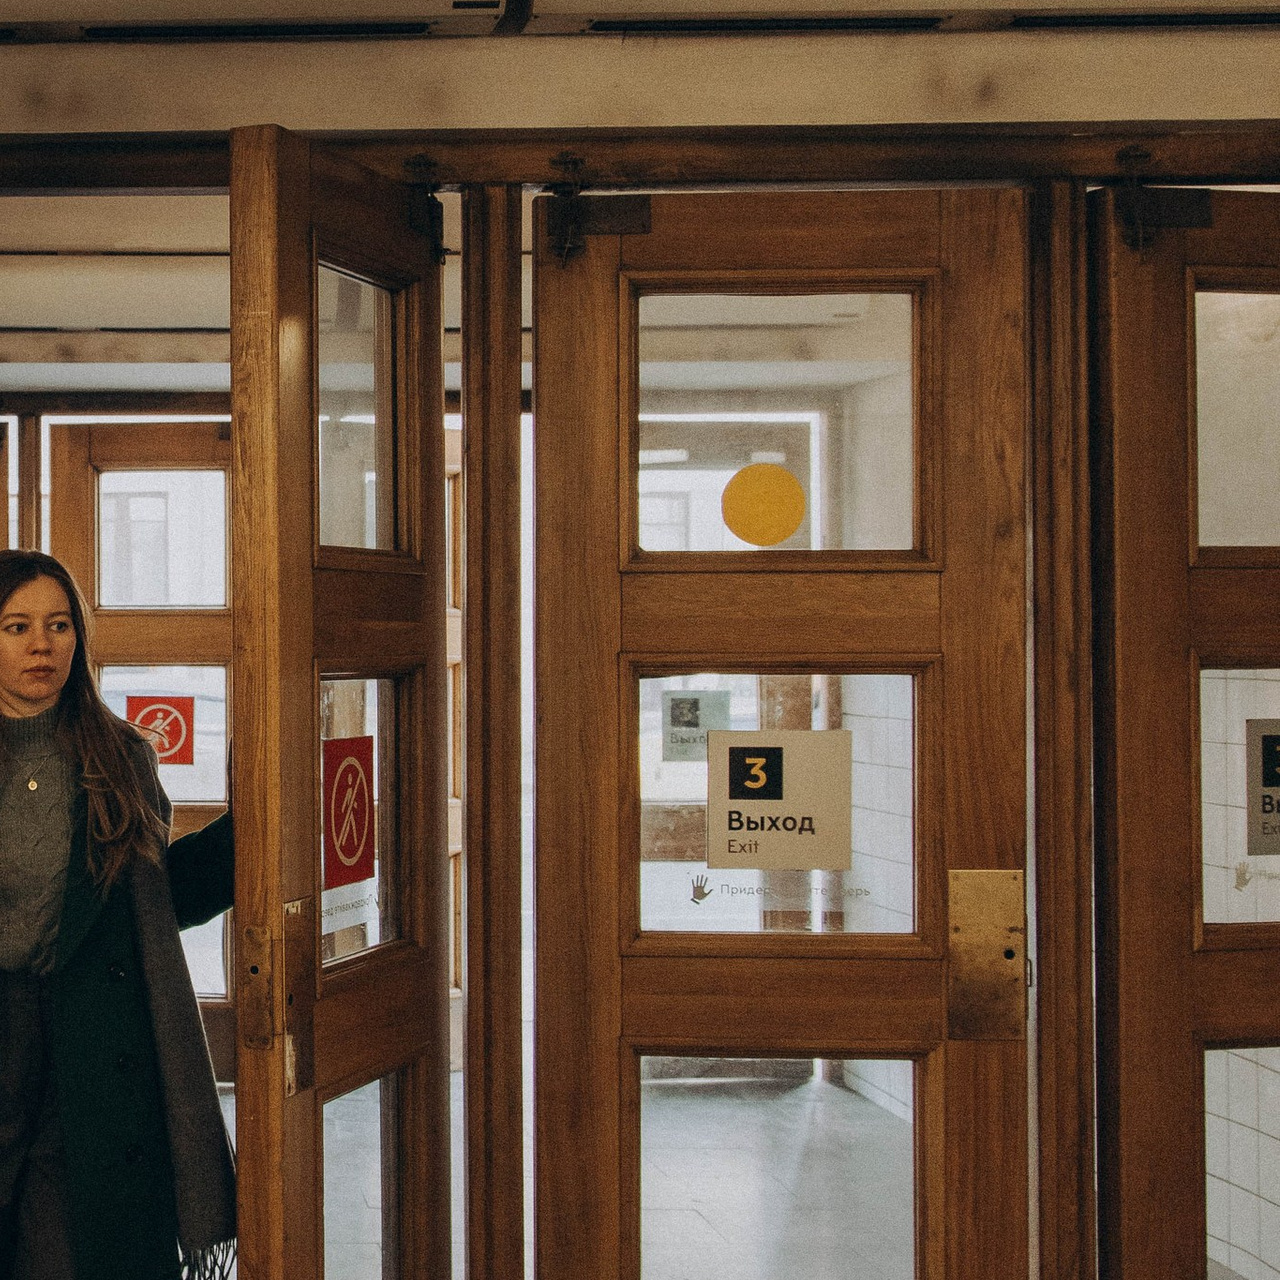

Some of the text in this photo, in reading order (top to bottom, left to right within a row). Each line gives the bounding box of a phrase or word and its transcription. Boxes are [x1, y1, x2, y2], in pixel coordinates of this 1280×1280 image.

[670, 733, 707, 744] Выхо
[744, 757, 767, 789] 3
[728, 810, 815, 835] Выход
[728, 839, 759, 853] Exit
